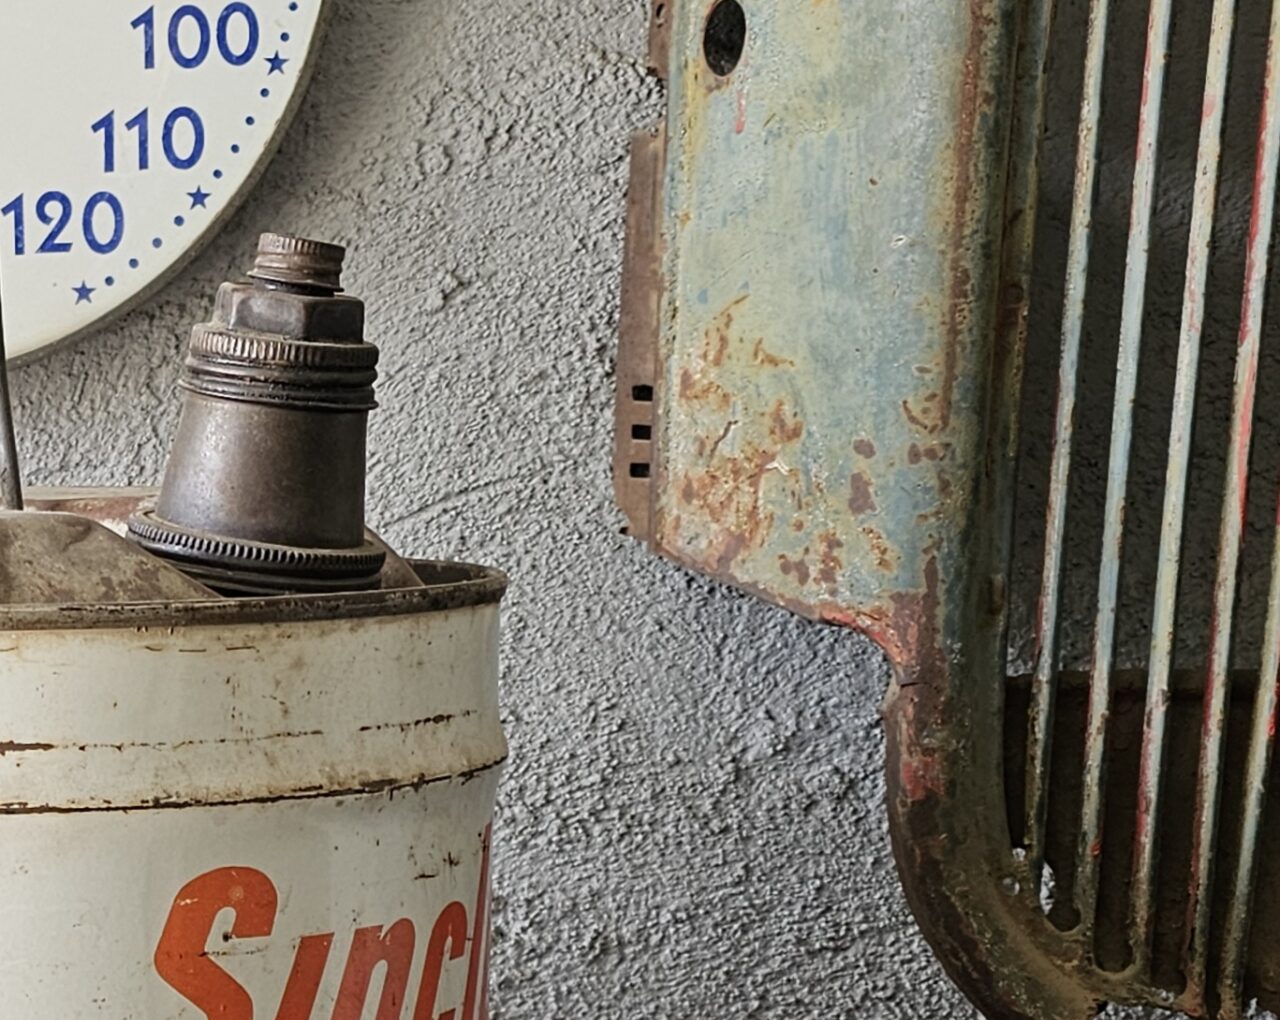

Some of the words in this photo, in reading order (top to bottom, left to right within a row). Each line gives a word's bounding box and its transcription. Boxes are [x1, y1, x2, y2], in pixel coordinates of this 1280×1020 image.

[130, 2, 259, 70] 100
[91, 106, 205, 173] 110
[0, 190, 125, 256] 120
